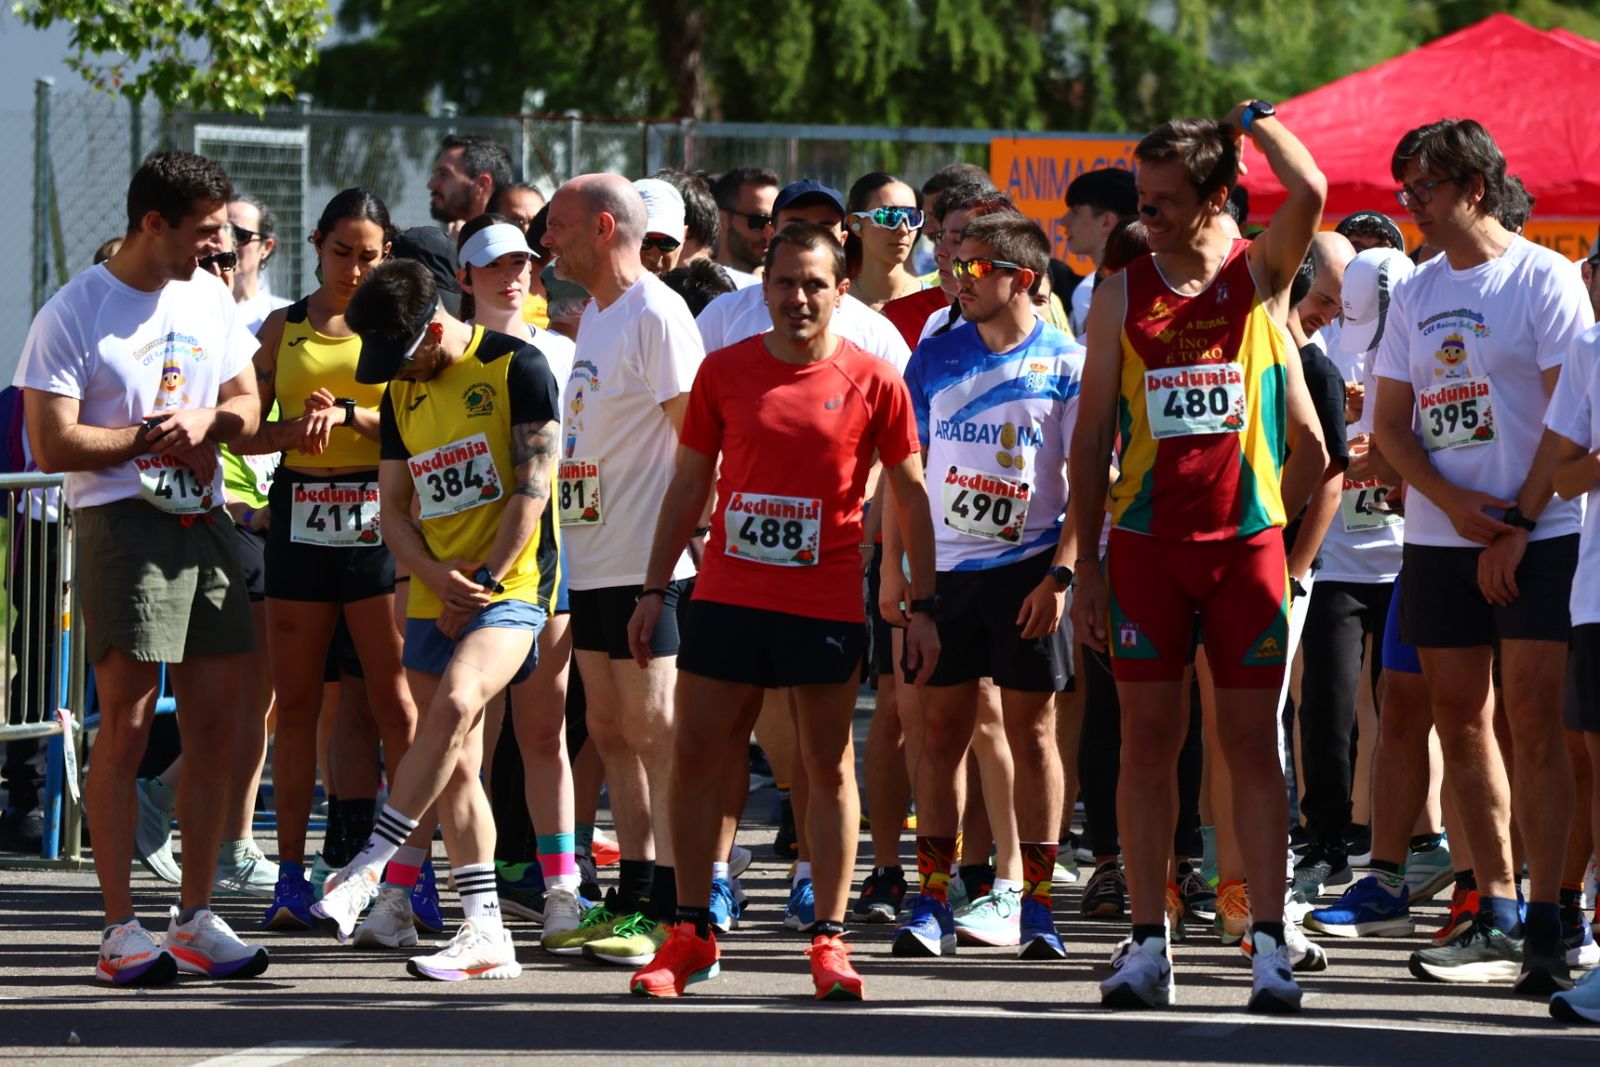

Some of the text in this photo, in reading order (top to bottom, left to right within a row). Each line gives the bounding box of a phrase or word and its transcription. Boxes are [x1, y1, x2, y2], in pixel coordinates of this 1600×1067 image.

[1178, 347, 1223, 361] TORO
[1179, 337, 1208, 350] INO
[1147, 368, 1241, 392] bedunia
[1163, 387, 1229, 419] 480
[1420, 381, 1489, 410] bedunia
[1429, 399, 1479, 437] 395
[410, 441, 488, 478] bedunia
[294, 487, 378, 503] bedunia
[427, 459, 484, 503] 384
[558, 480, 585, 510] 81
[944, 472, 1028, 502] bedunia
[306, 504, 362, 532] 411
[729, 497, 818, 521] bedunia
[951, 489, 1012, 526] 490
[739, 516, 803, 551] 488
